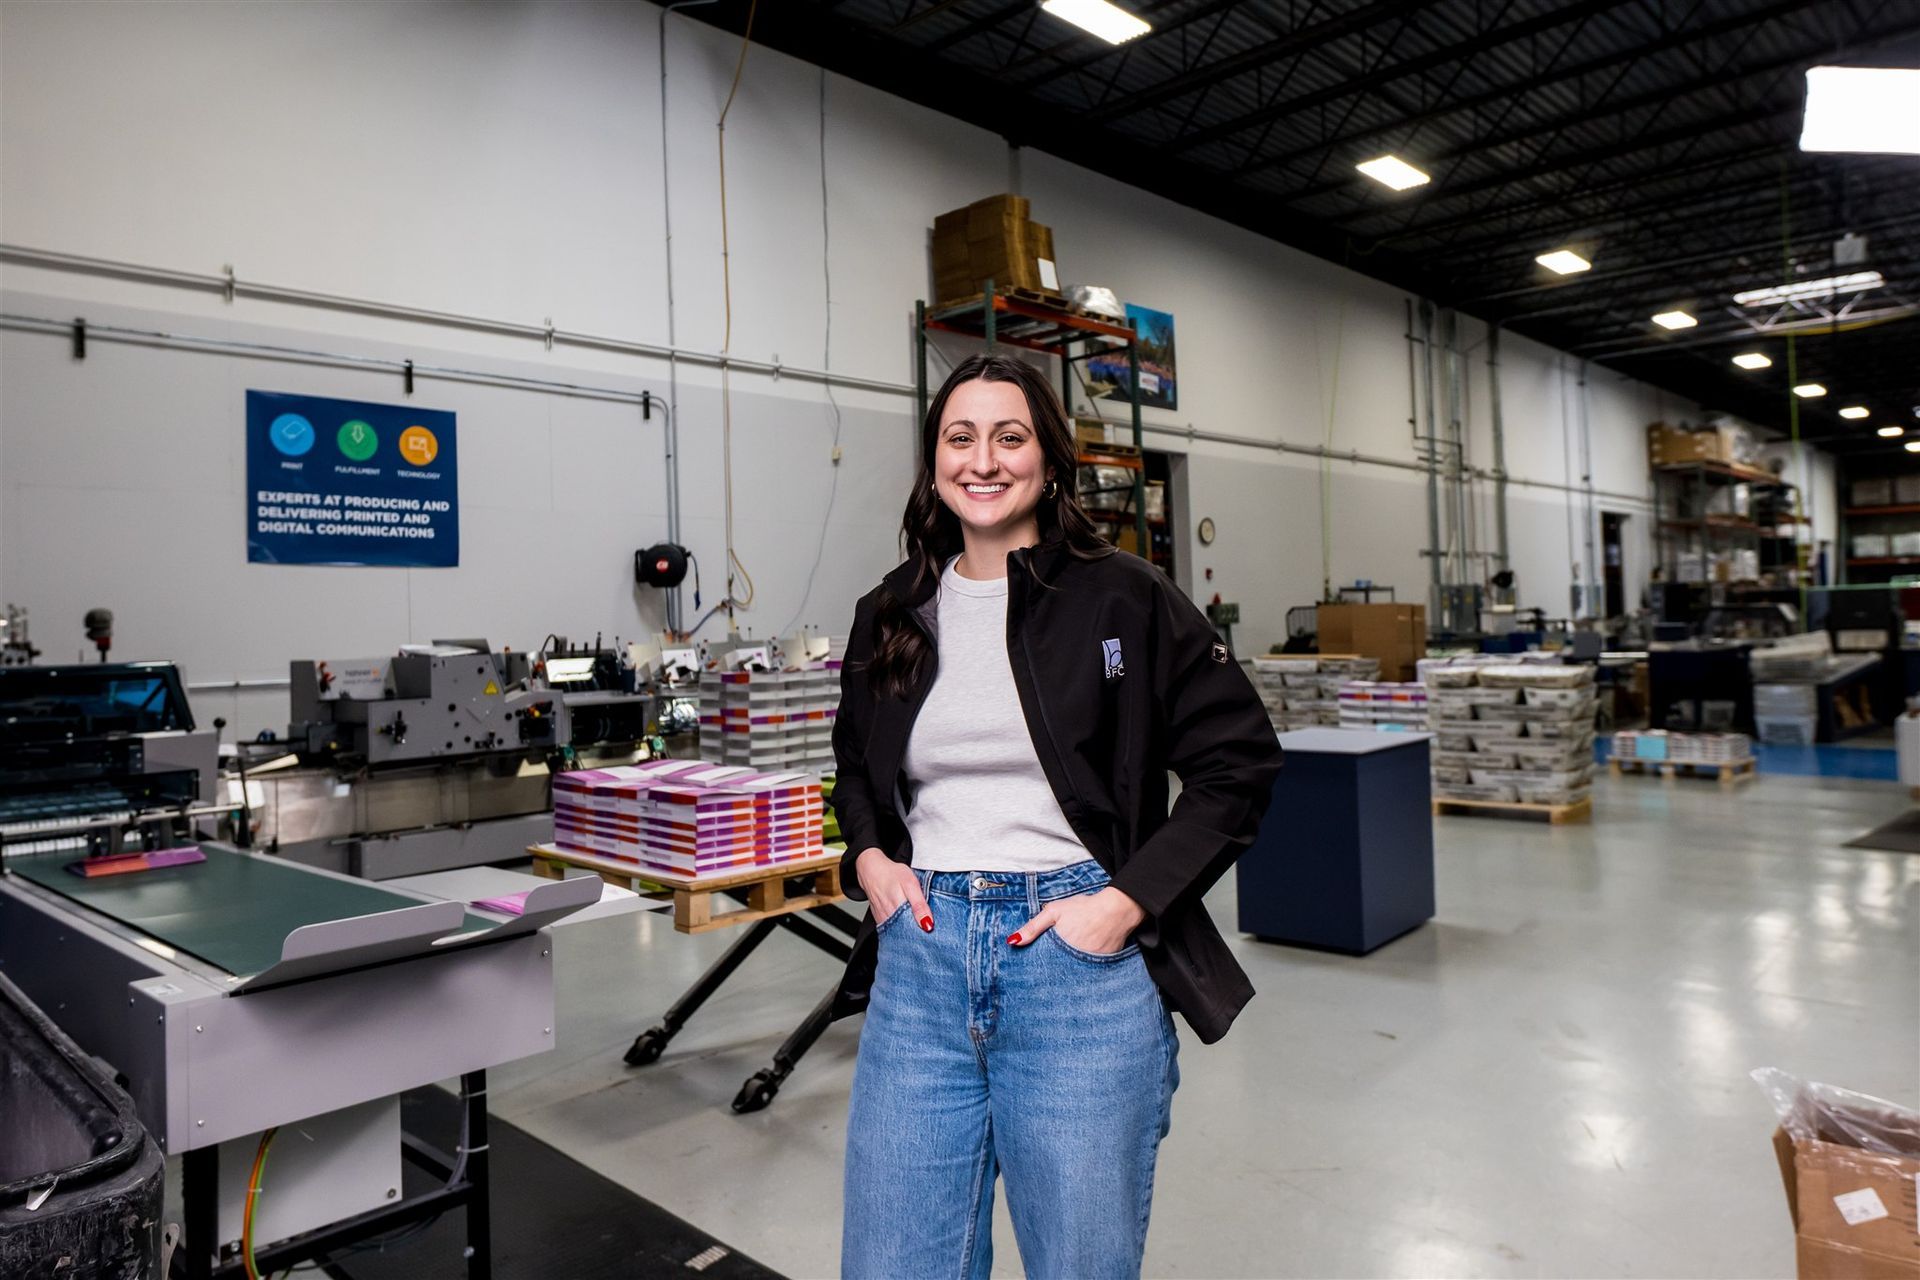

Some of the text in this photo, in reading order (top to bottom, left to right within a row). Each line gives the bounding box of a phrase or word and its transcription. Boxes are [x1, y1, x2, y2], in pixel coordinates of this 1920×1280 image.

[281, 461, 303, 470] PRINT
[335, 465, 380, 475] FULFILLMENT
[397, 470, 440, 480] TECHNOLOGY
[258, 491, 450, 512] EXPERTS AT PRODUCING AND
[258, 506, 430, 524] DELIVERING PRINTED AND
[258, 522, 435, 538] DIGITAL COMMUNICATIONS
[1105, 666, 1125, 679] BFC
